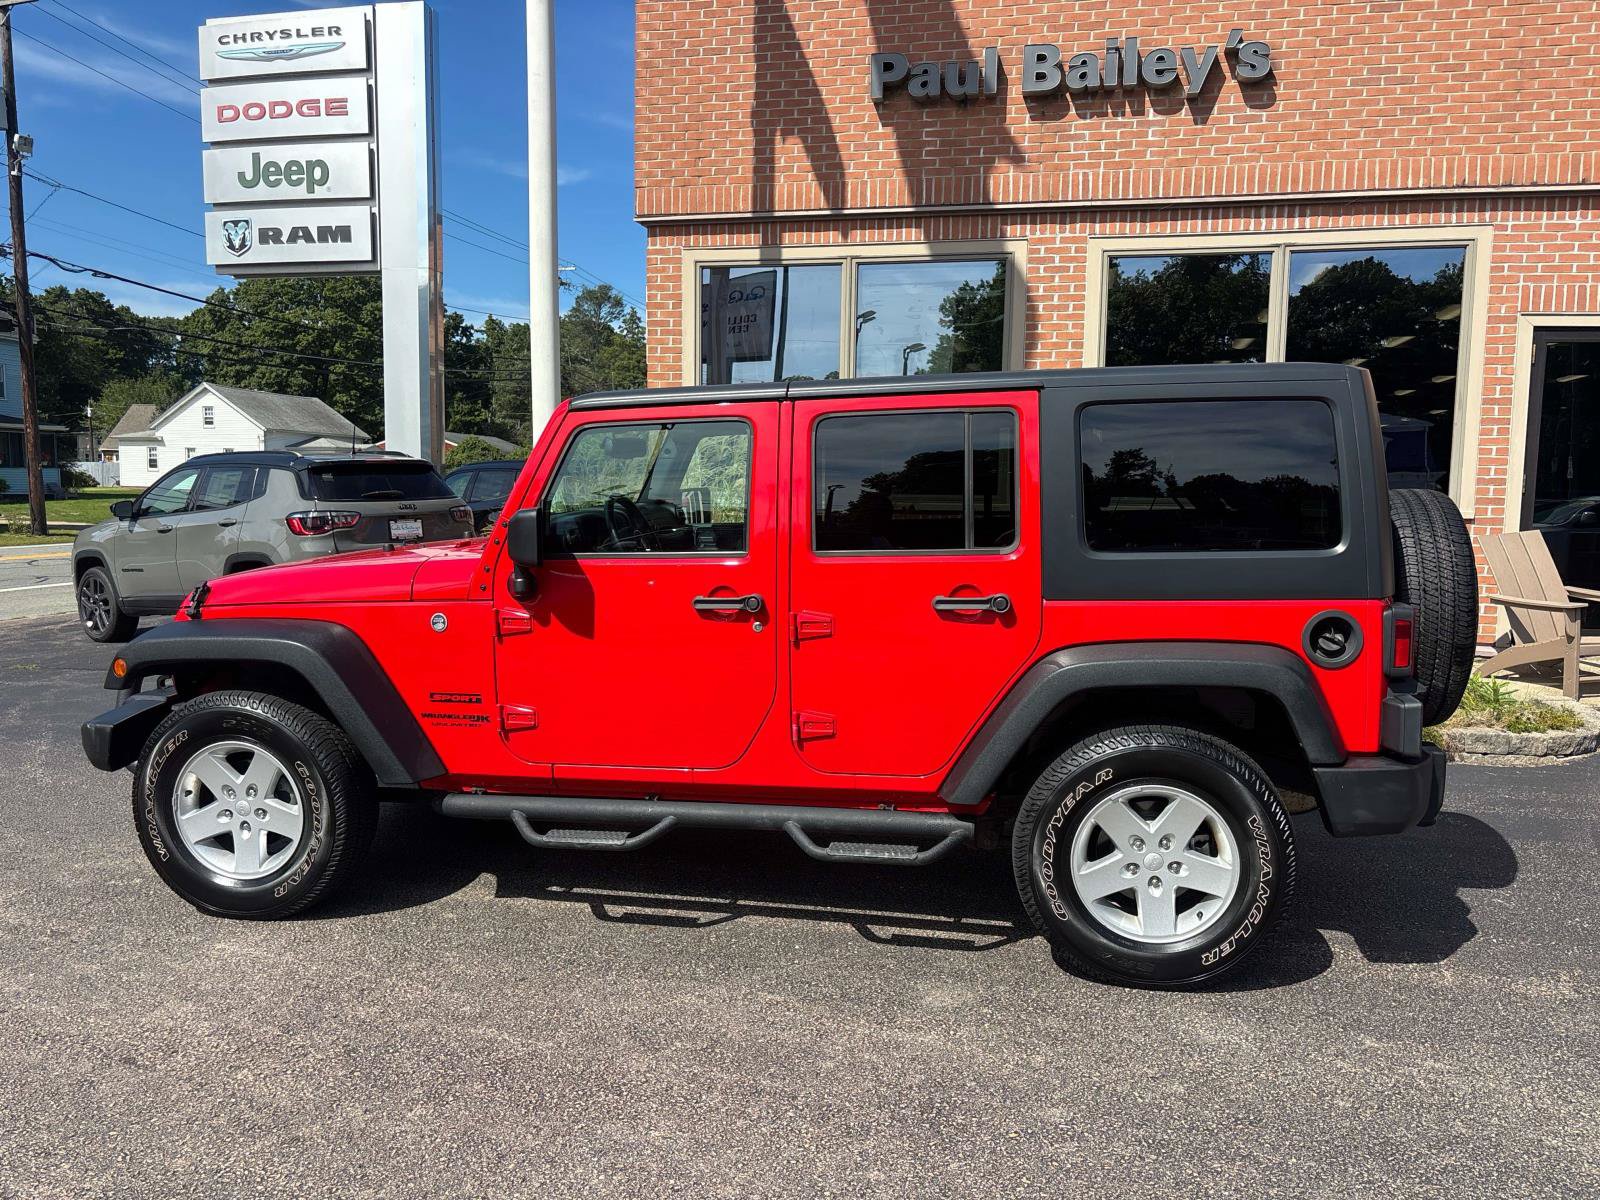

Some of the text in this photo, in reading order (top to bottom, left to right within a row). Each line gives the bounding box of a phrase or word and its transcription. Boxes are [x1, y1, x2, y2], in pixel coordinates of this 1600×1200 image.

[217, 25, 343, 46] CHRYSLER
[870, 29, 1272, 101] Paul Bailey's
[216, 97, 349, 124] DODGE
[237, 152, 330, 194] Jeep
[258, 225, 352, 246] RAM
[431, 693, 482, 703] SPORT
[145, 729, 189, 863] WRANGLER
[274, 760, 324, 899] GOODYEAR
[1042, 767, 1114, 921] GOODYEAR
[1201, 814, 1274, 967] WRANGLER
